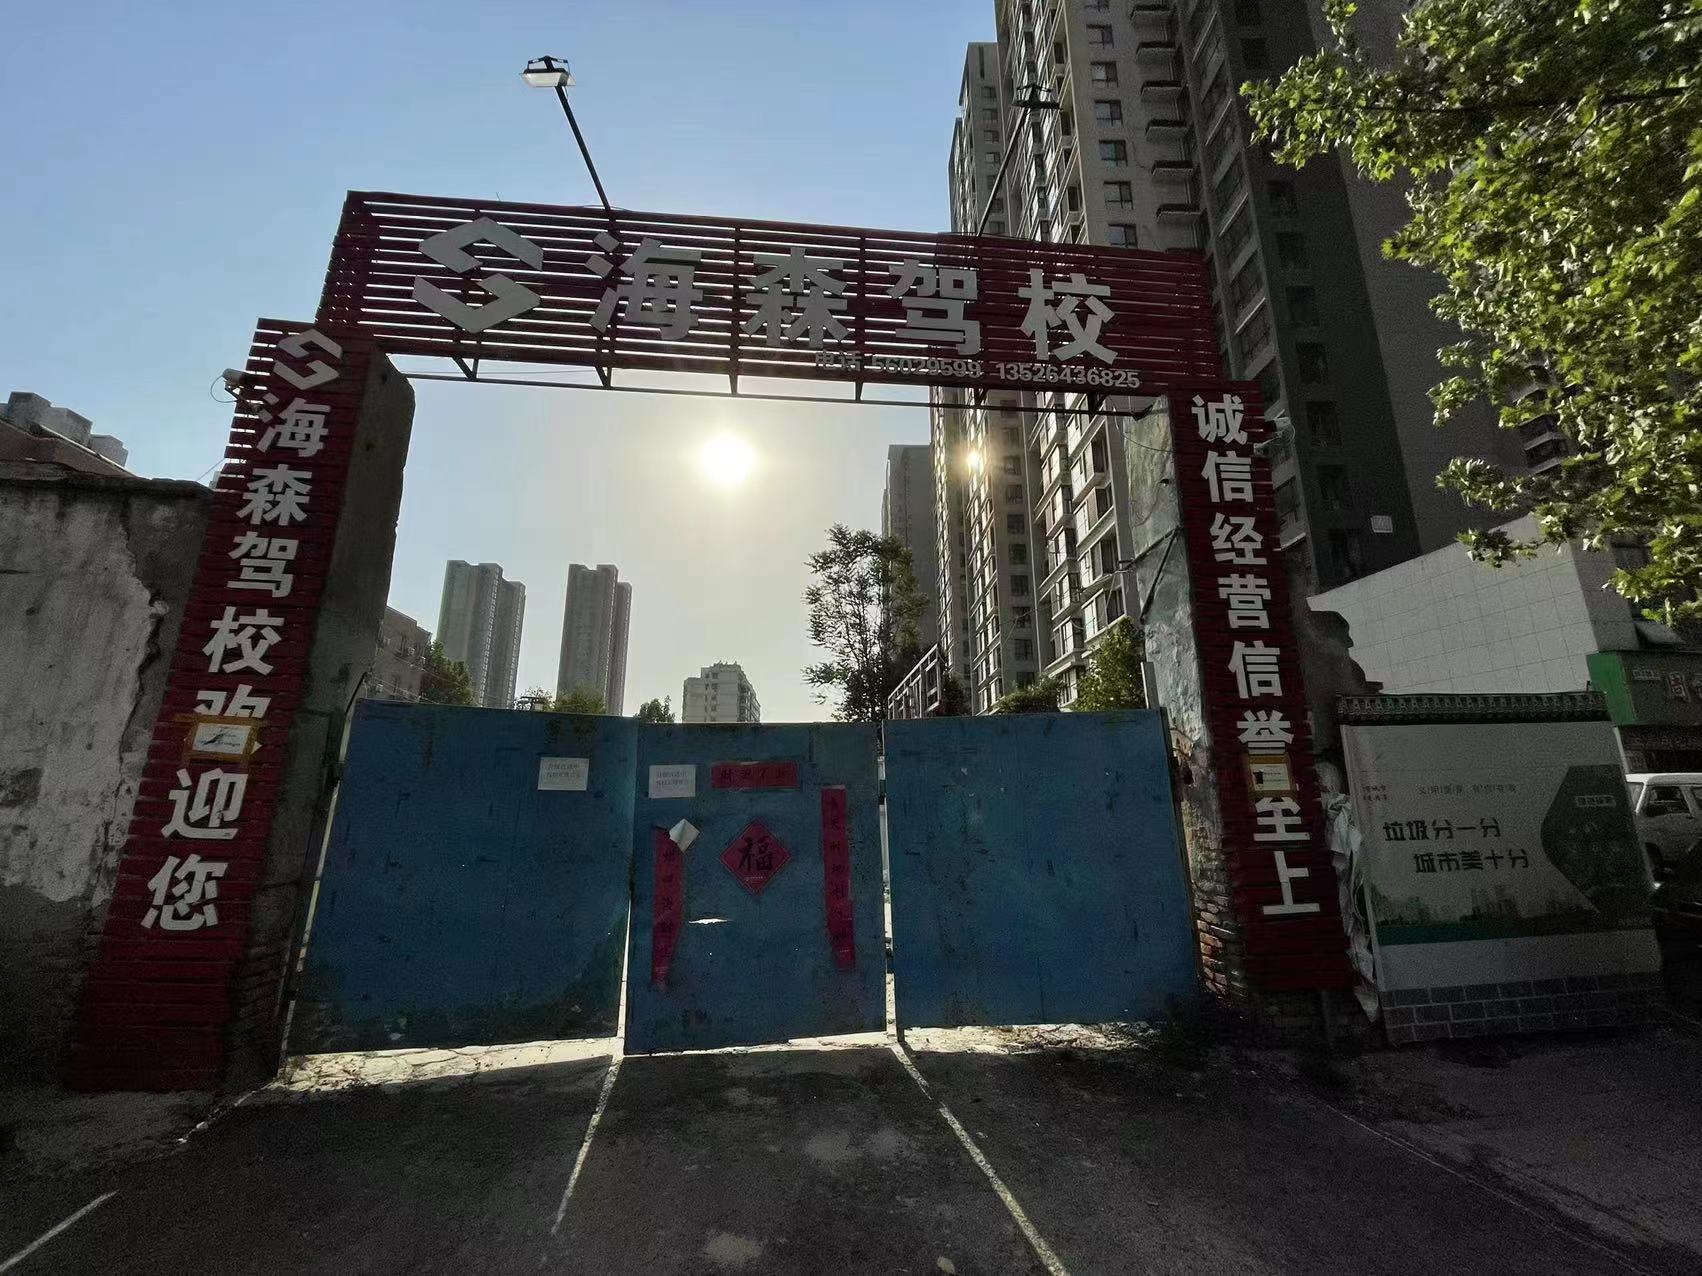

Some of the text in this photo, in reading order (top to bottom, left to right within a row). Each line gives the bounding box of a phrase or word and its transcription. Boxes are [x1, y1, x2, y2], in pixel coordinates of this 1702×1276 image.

[584, 236, 1118, 364] 海森驾校
[871, 354, 982, 379] 56029599
[995, 362, 1141, 390] 13526436825
[1383, 817, 1501, 842] 垃圾分一分
[738, 835, 773, 872] 福
[1413, 848, 1530, 874] 城市美十分
